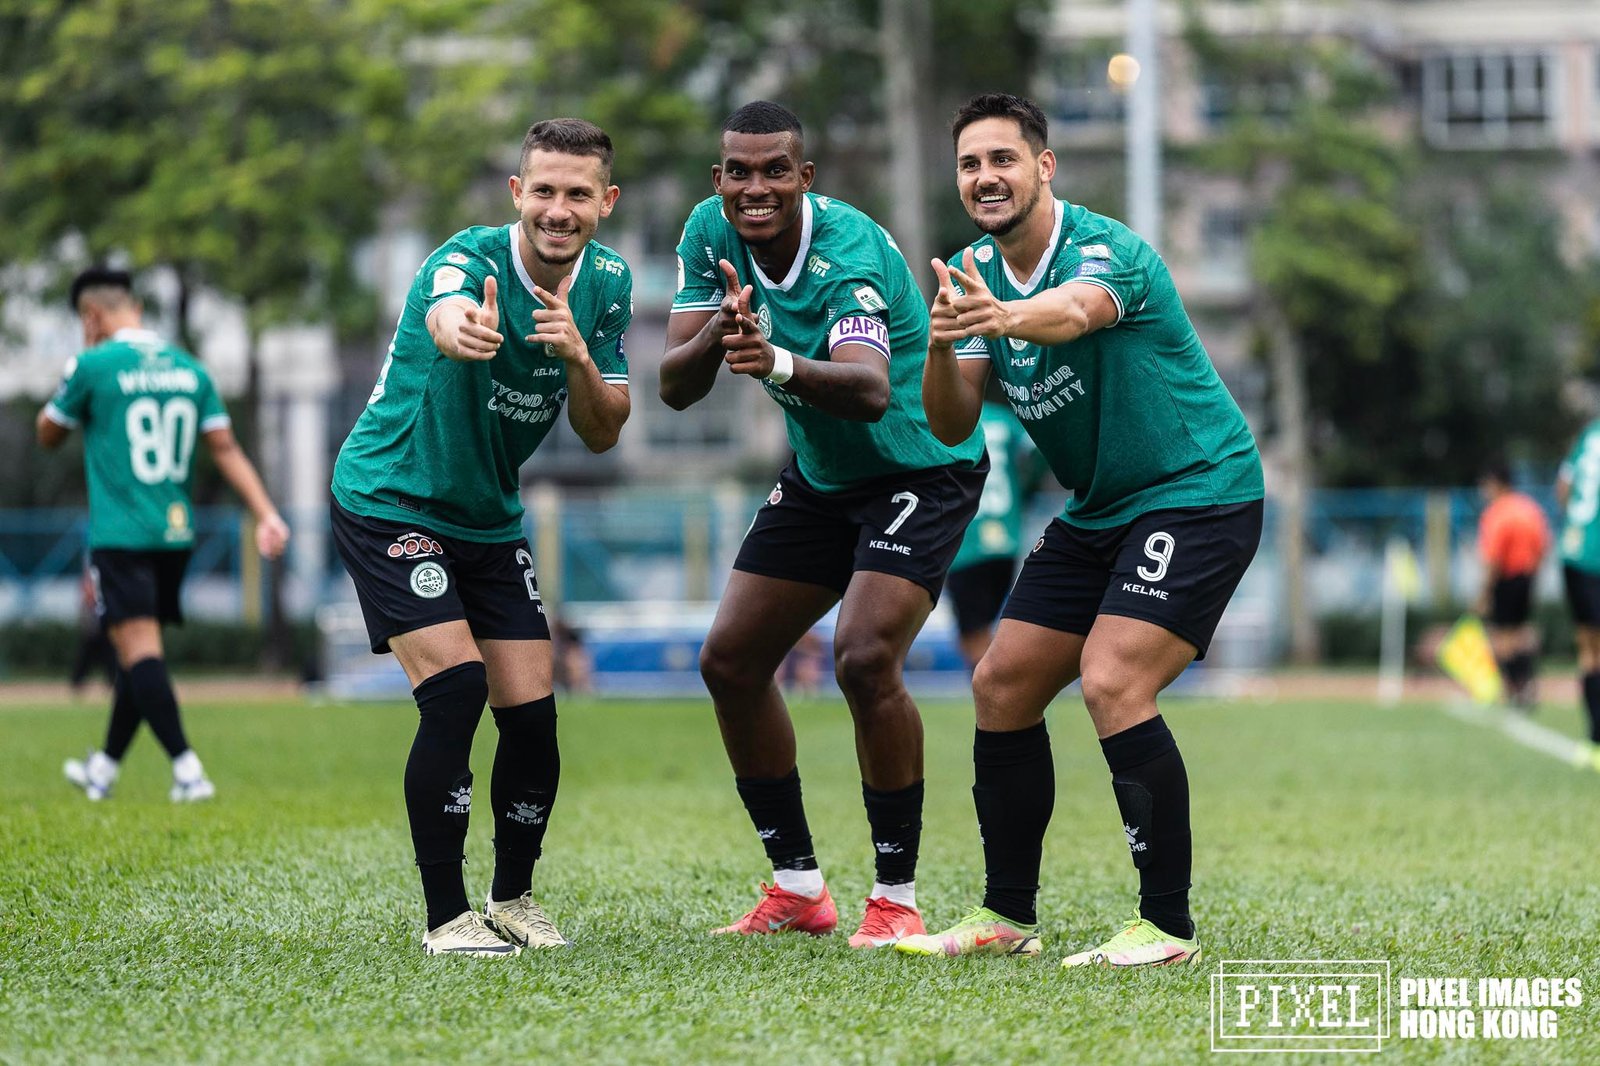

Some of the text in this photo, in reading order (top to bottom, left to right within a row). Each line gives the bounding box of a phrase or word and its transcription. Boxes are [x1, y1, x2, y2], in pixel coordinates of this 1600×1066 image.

[125, 396, 198, 485] 80
[884, 491, 919, 536] 7
[869, 539, 912, 556] KELME
[1136, 531, 1176, 582] 9
[1122, 582, 1169, 601] KELME
[506, 811, 544, 825] KELME
